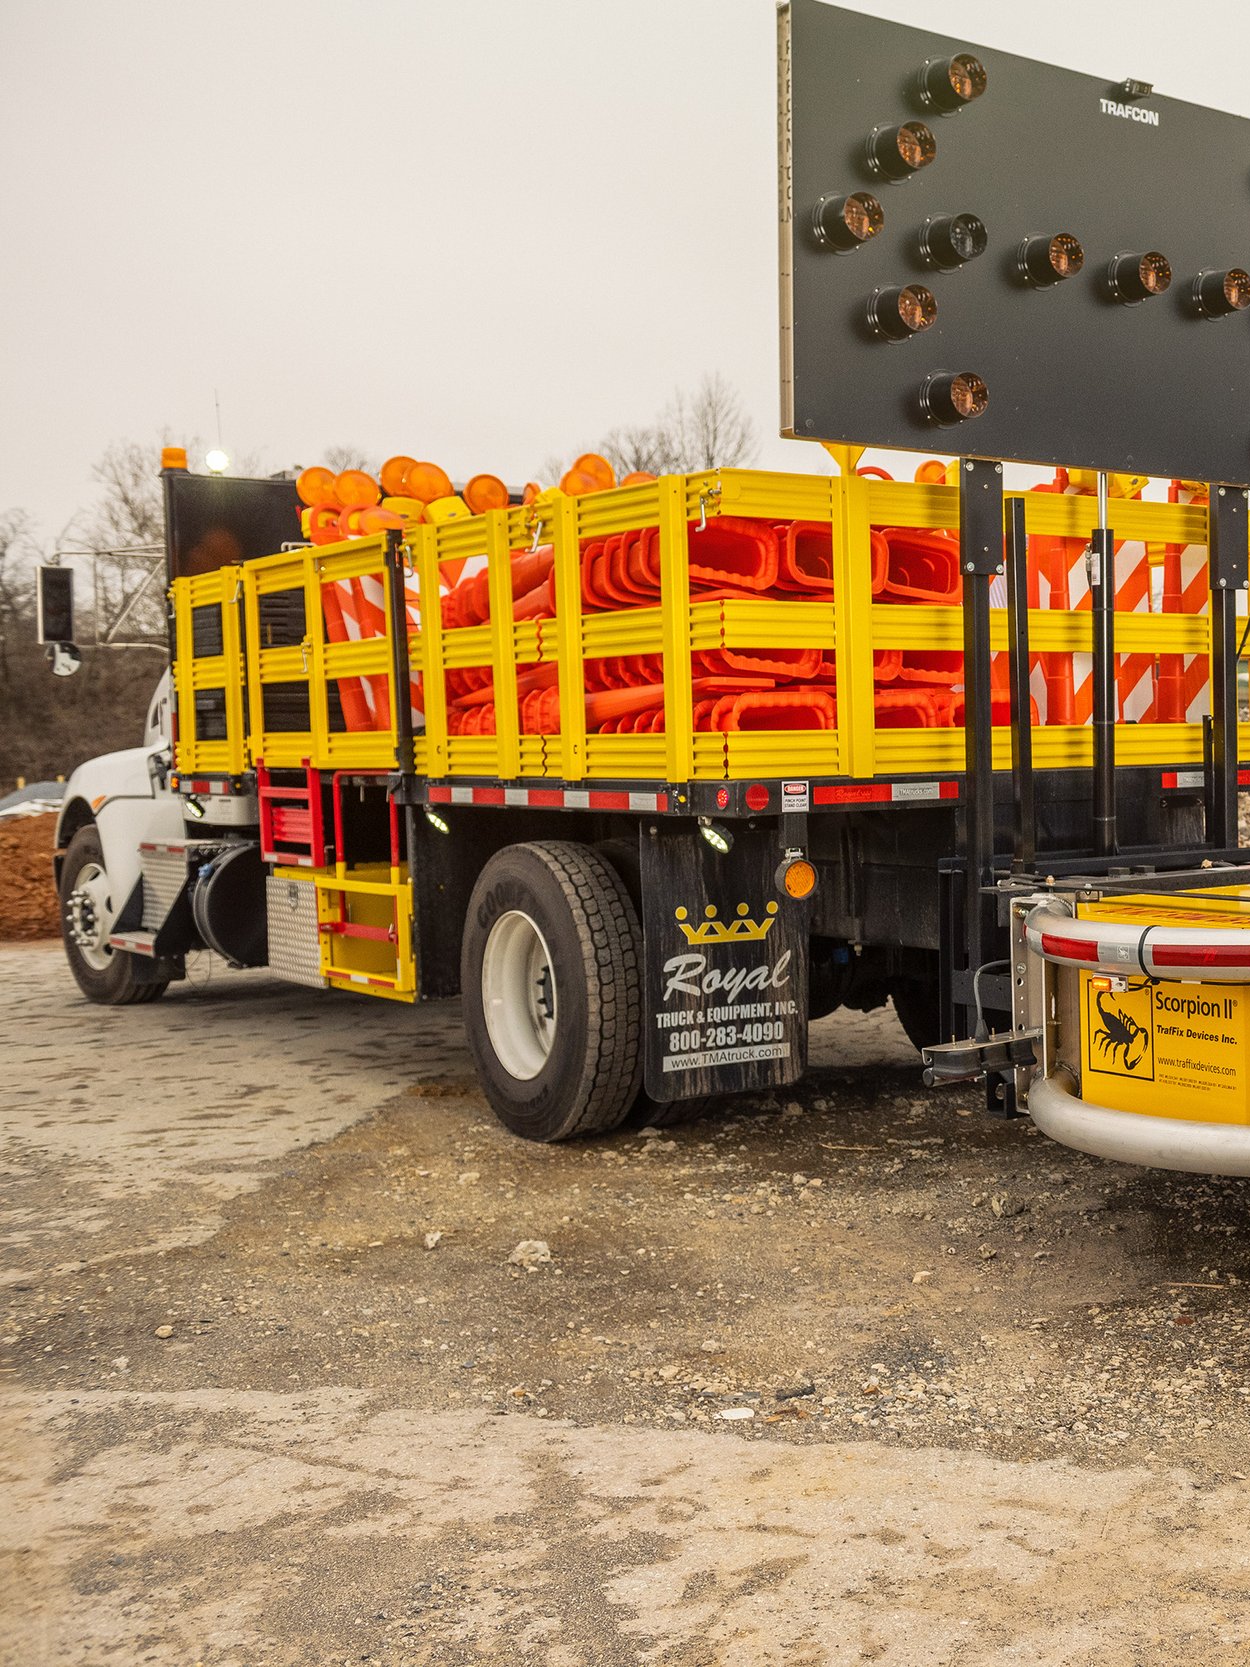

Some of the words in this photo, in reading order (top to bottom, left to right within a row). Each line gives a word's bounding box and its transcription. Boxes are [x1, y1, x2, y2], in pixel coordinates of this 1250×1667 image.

[1100, 98, 1159, 126] TRAFCON
[663, 949, 791, 1004] Royal
[656, 1010, 695, 1028] TRUCK
[696, 1011, 705, 1023] &
[707, 1002, 773, 1023] EQUIPMENT,
[775, 1000, 799, 1016] INC.
[1155, 991, 1220, 1019] Scorpion
[669, 1021, 784, 1052] 800-283-4090
[1156, 1024, 1184, 1037] TrafFix
[1186, 1029, 1219, 1043] Devices
[1221, 1034, 1238, 1045] Inc.
[671, 1047, 783, 1069] www.TMAtruck.com
[1157, 1056, 1237, 1077] www.traffixdevices.com
